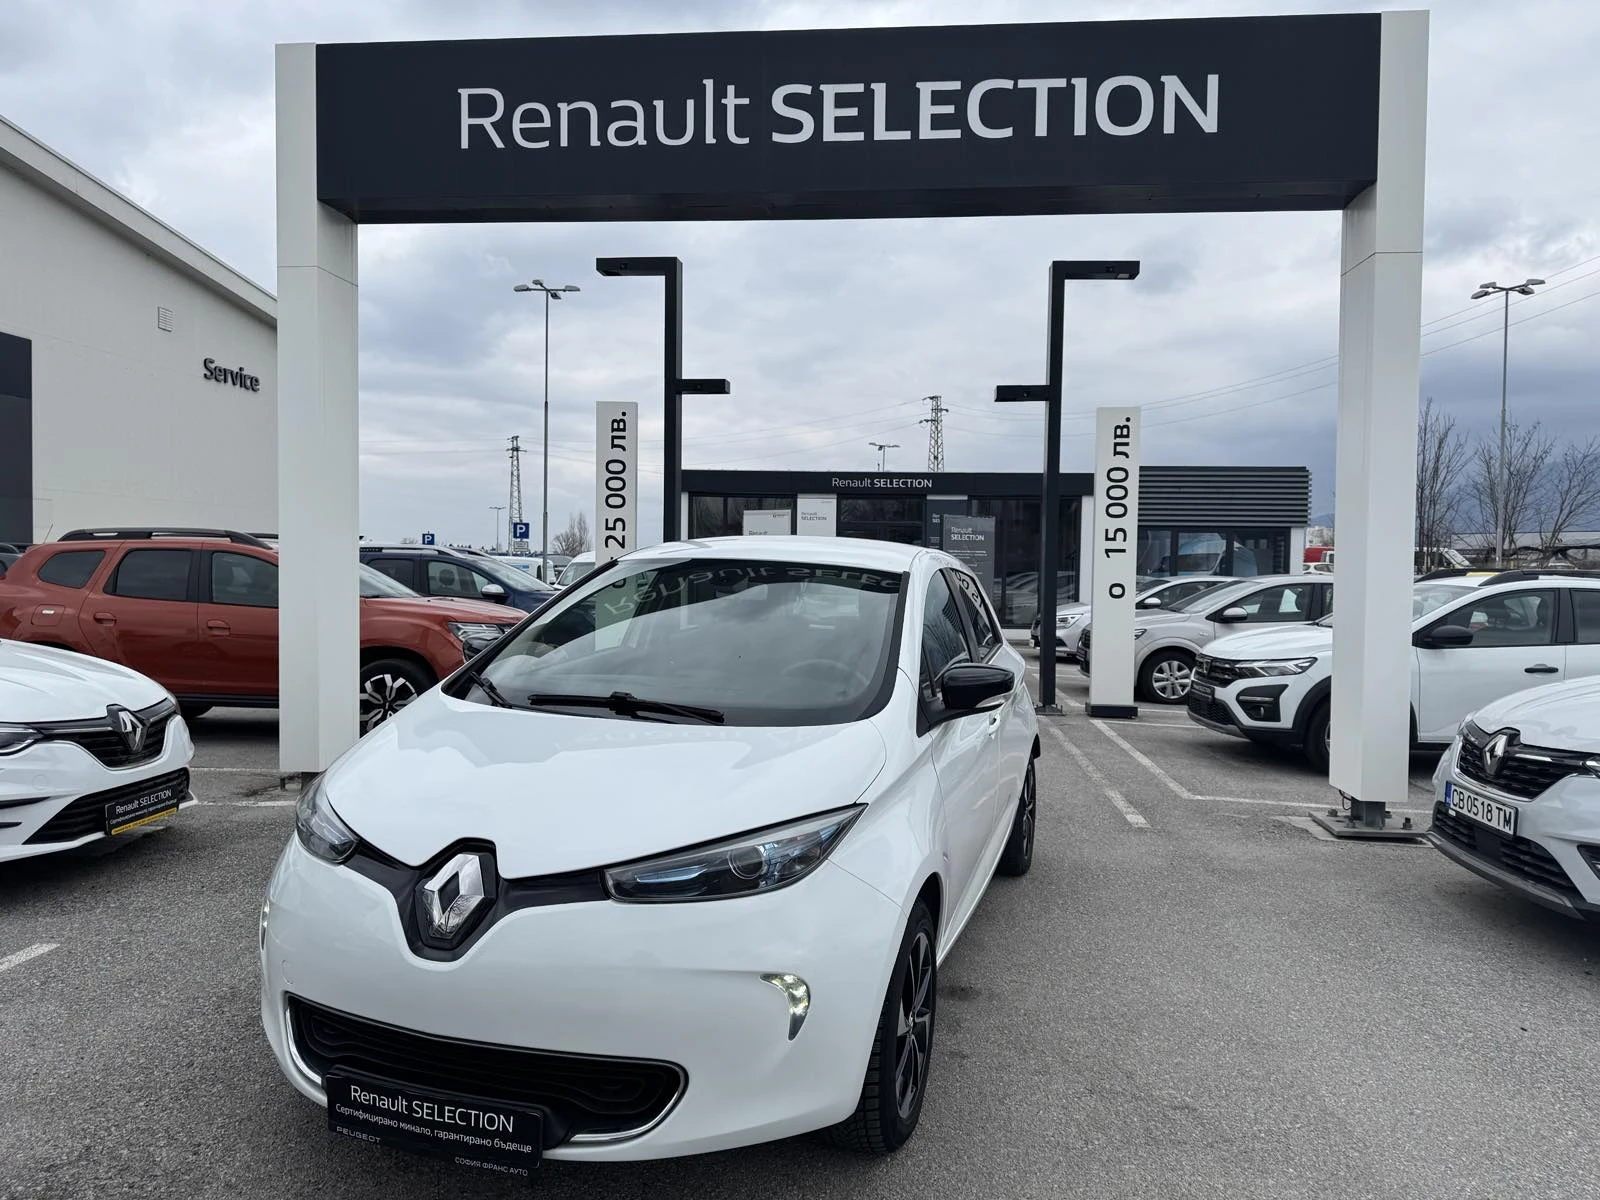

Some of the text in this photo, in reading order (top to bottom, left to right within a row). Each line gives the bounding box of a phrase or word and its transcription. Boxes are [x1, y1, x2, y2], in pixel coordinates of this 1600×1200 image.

[457, 74, 1219, 149] Renault SELECTION
[203, 357, 260, 392] Service
[611, 411, 627, 451] лв.
[1113, 417, 1131, 459] лв.
[604, 459, 627, 509] 000
[832, 477, 932, 488] Renault SELECTION
[1105, 466, 1129, 519] 000
[424, 534, 433, 544] P
[517, 525, 526, 537] P
[604, 517, 626, 549] 25
[1105, 527, 1127, 558] 15
[115, 801, 139, 815] Renault
[140, 789, 172, 807] SELECTION
[1466, 795, 1493, 823] 0518
[350, 1084, 514, 1133] Renault SELECTION
[335, 1103, 532, 1153] Сертифицирано минало, гарантирано бъдеще
[336, 1126, 381, 1143] PEUGEOT
[454, 1156, 528, 1177] СОФИЯ ФРАНС АУТО
